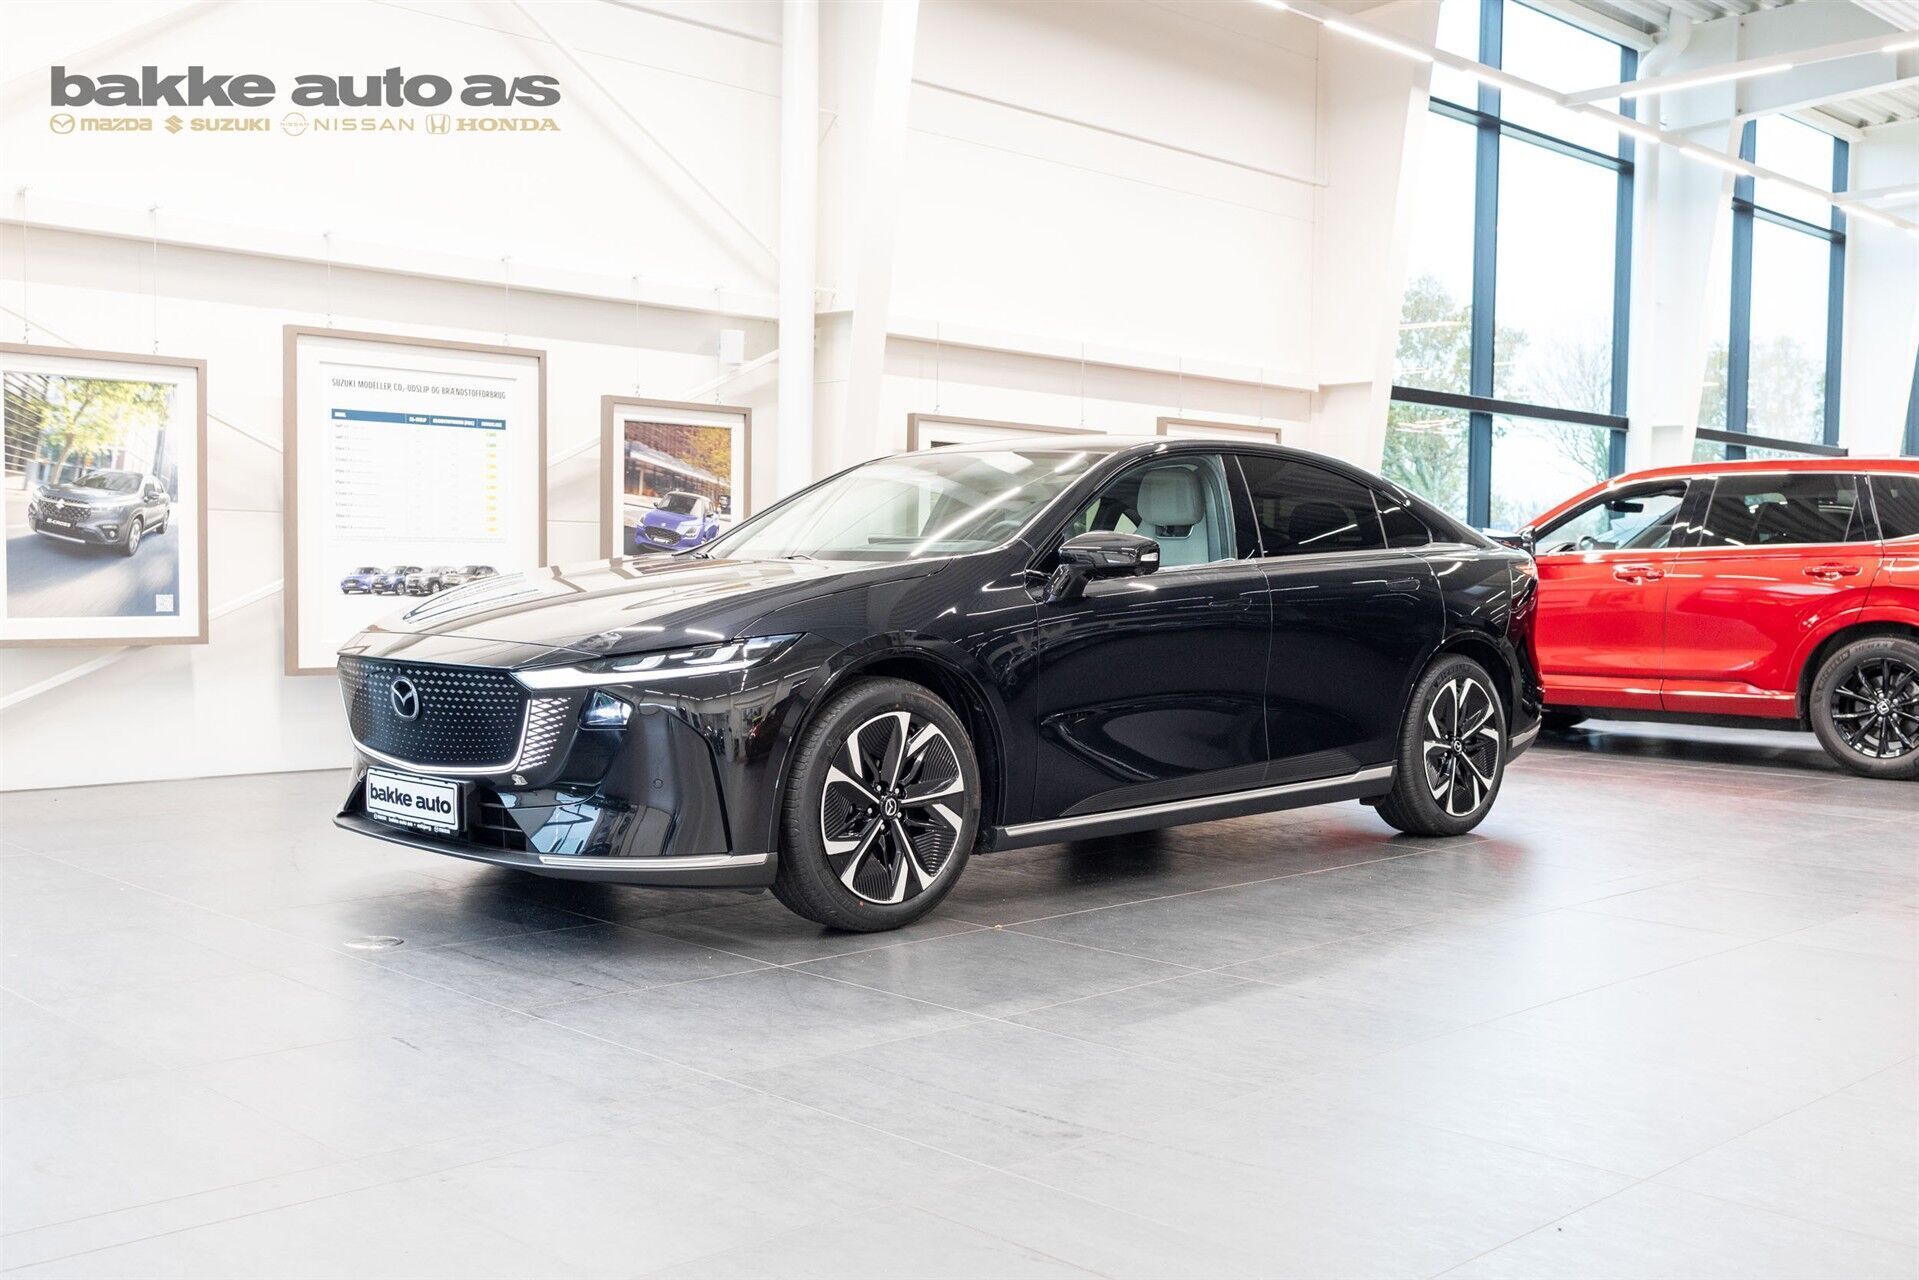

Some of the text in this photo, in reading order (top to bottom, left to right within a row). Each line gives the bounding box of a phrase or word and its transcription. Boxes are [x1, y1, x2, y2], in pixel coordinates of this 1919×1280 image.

[331, 378, 356, 387] SUZUKI
[358, 380, 392, 391] MODELLER
[431, 386, 440, 394] OG
[370, 783, 452, 815] bakke auto
